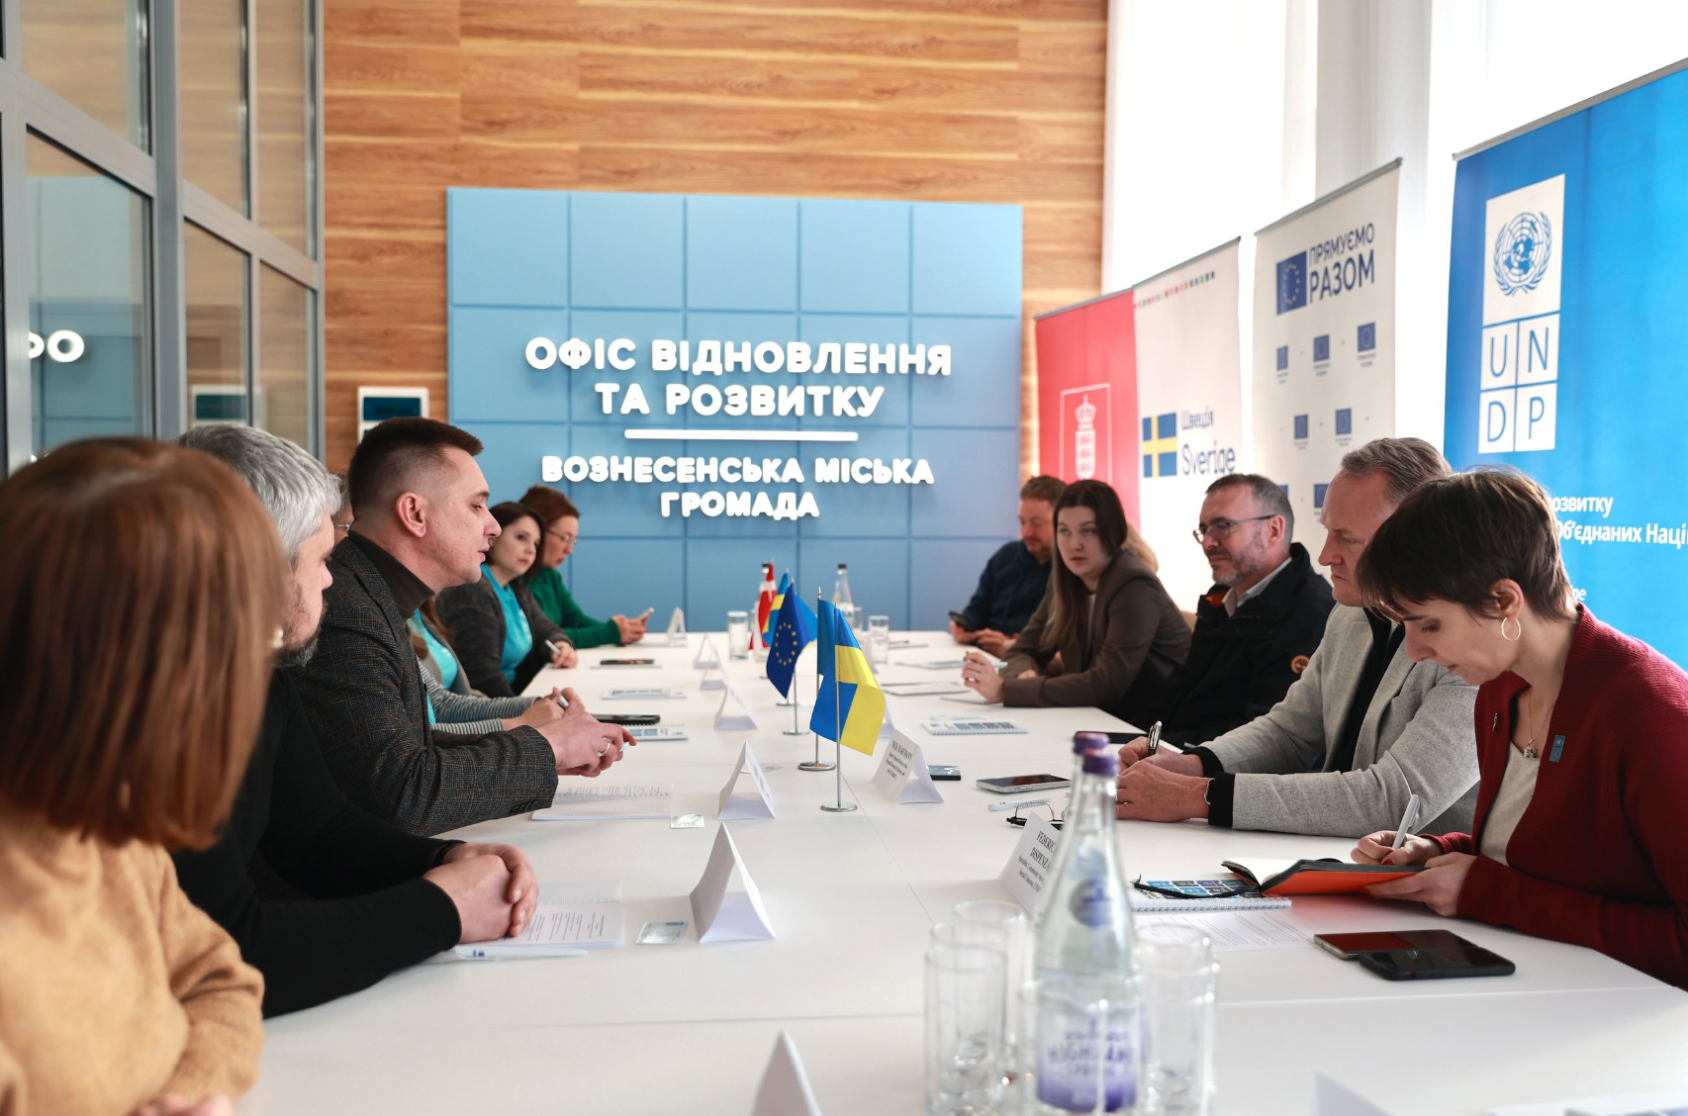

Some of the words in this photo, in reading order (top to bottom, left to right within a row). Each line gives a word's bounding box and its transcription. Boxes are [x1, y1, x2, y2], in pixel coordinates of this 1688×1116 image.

[1309, 223, 1375, 266] ПРЯМУЄМО
[1310, 249, 1375, 303] РАЗОМ
[525, 337, 636, 370] ОФІС
[652, 339, 951, 376] ВІДНОВЛЕННЯ
[594, 383, 650, 415] ТА
[666, 383, 885, 418] РОЗВИТКУ
[542, 455, 804, 484] ВОЗНЕСЕНСЬКА
[815, 457, 935, 484] МІСЬКА
[1182, 440, 1235, 475] Sverige
[661, 490, 820, 521] ГРОМАДА
[1549, 496, 1614, 518] озвитку
[1646, 523, 1688, 549] Наці
[1036, 830, 1057, 853] FEDERIC
